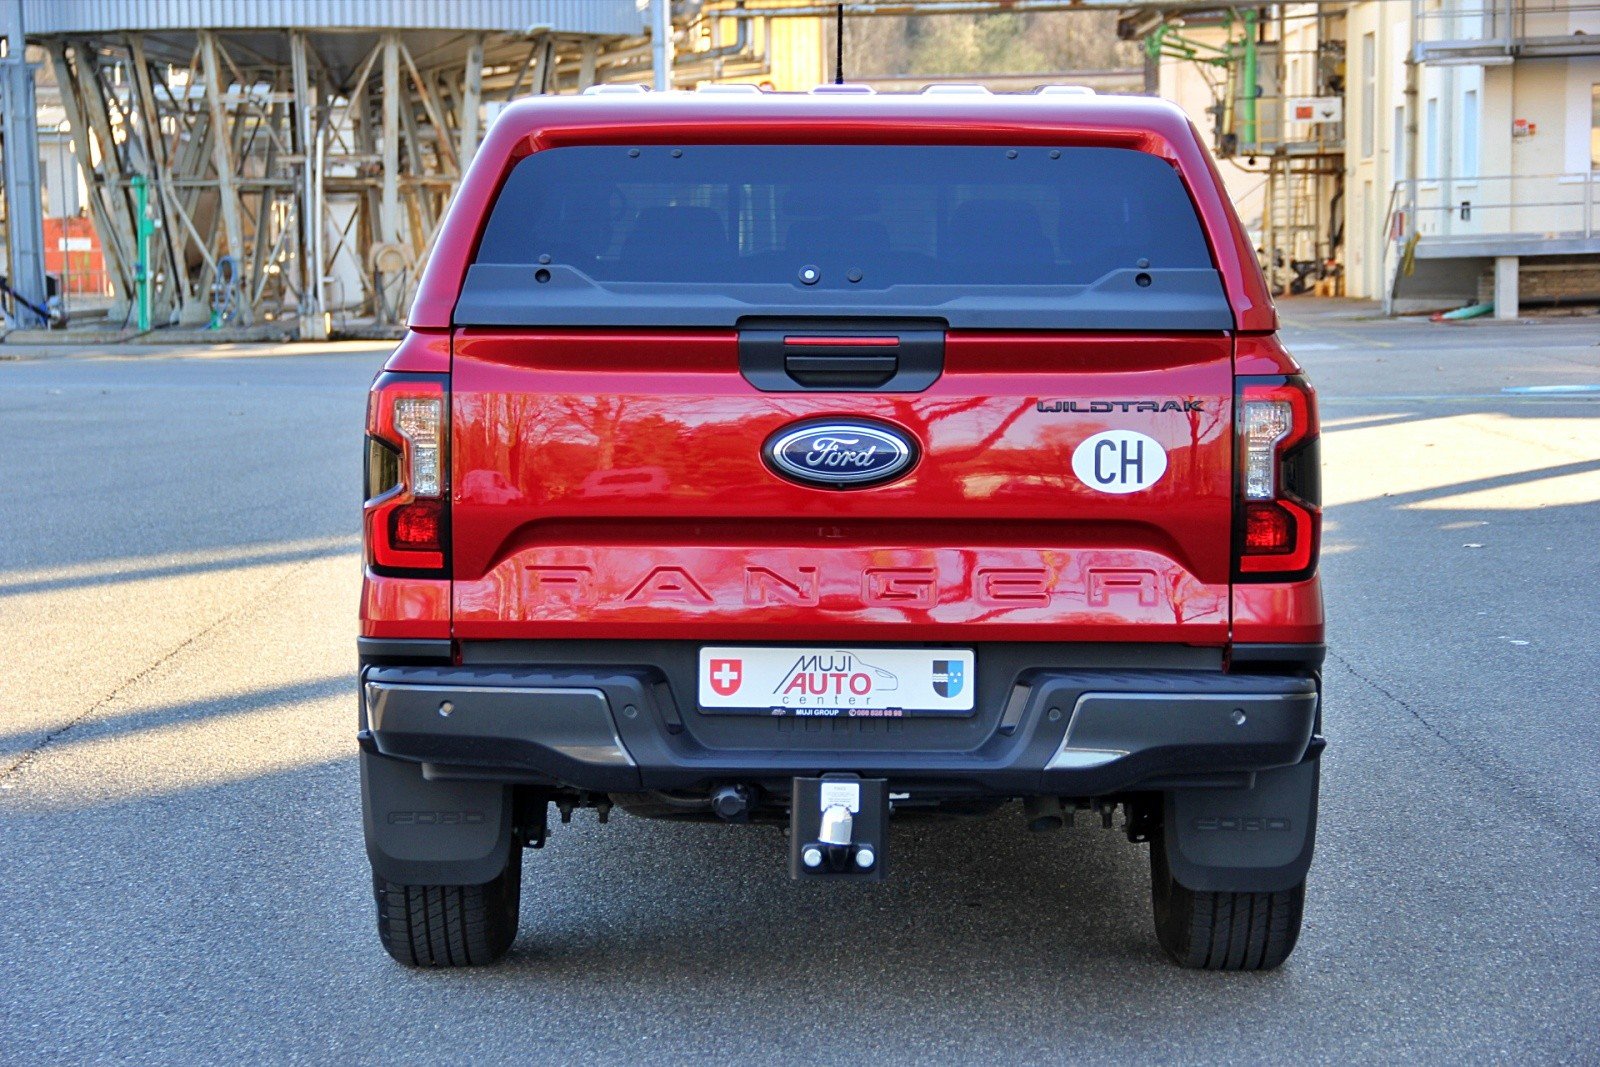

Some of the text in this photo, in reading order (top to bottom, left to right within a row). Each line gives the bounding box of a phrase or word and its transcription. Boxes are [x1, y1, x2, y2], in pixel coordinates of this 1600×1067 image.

[1036, 400, 1205, 413] WILDTRAK
[805, 437, 877, 467] Ford
[1094, 439, 1144, 485] CH
[522, 565, 1159, 607] RANGER
[783, 672, 872, 696] AUTO
[782, 695, 872, 705] center
[387, 811, 486, 825] FORD
[1192, 816, 1292, 832] FORD
